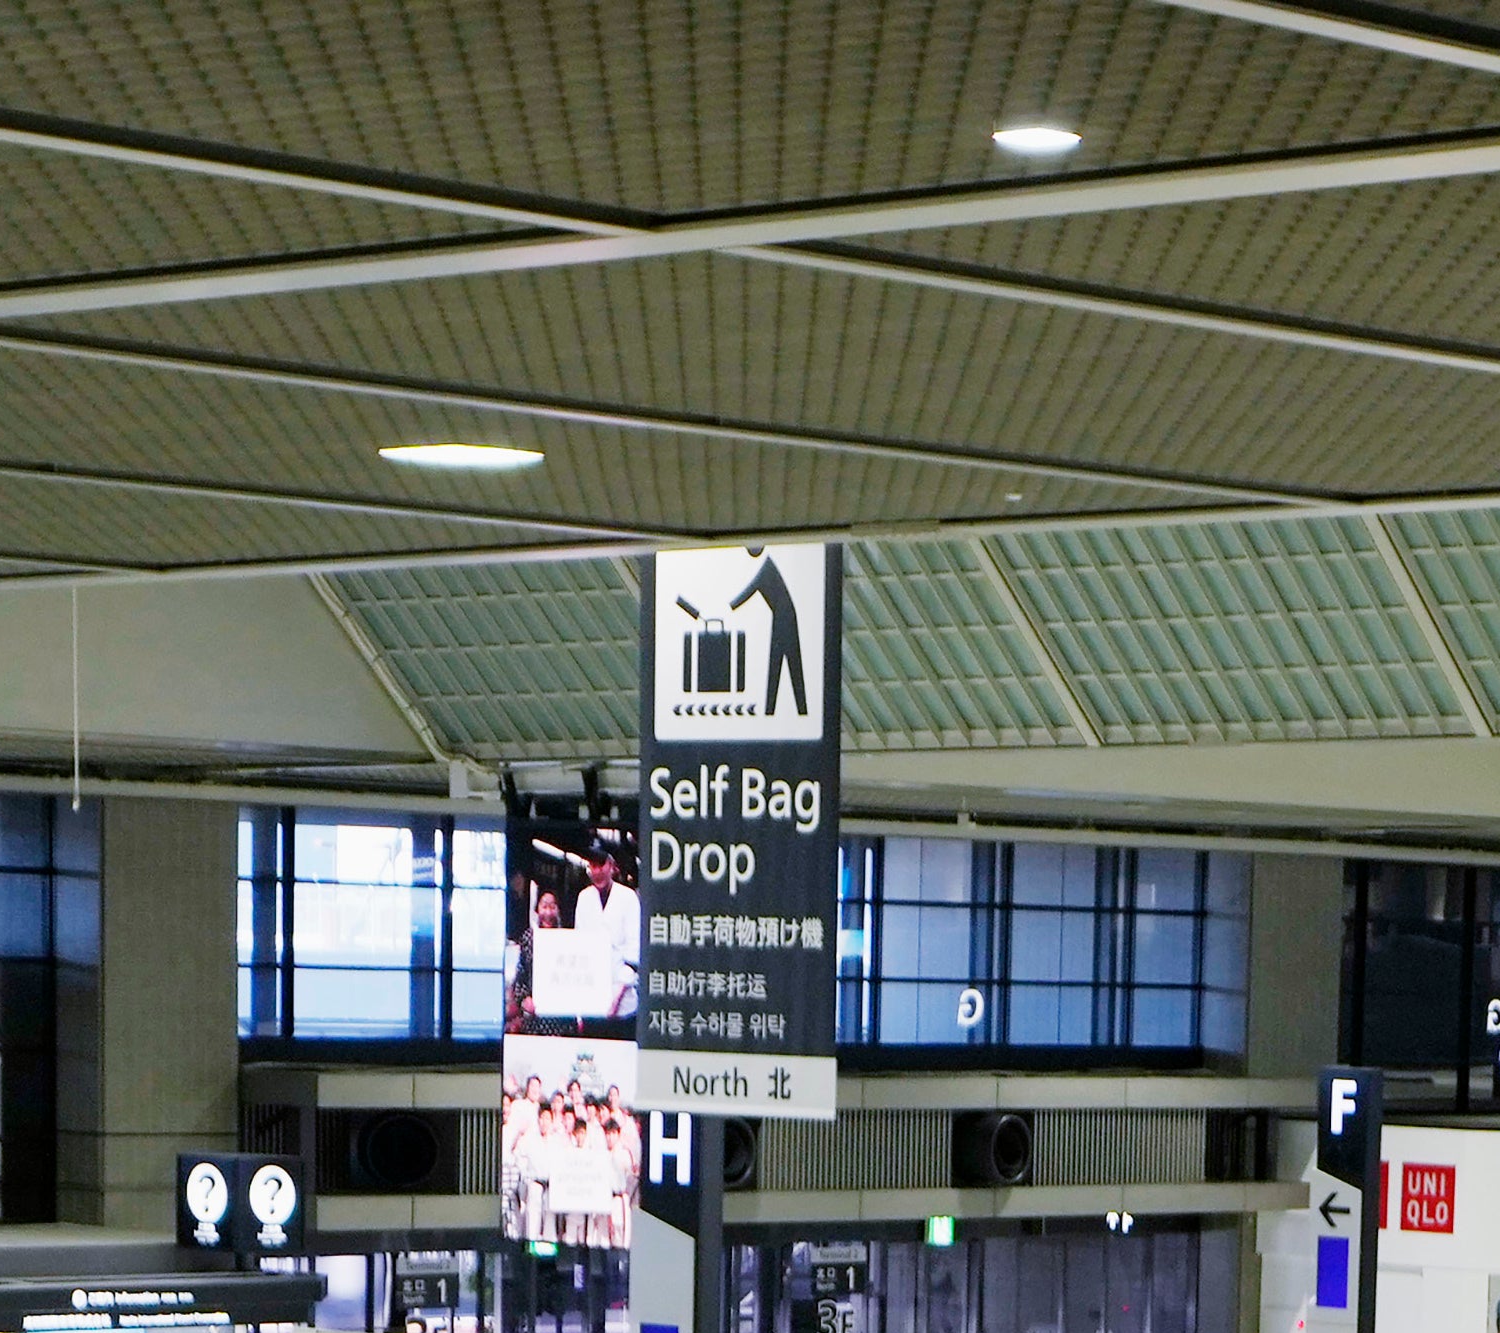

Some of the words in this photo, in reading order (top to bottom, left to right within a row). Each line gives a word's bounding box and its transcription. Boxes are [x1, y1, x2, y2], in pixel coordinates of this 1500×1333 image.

[650, 764, 729, 820] Self
[741, 767, 821, 833] Bag
[651, 830, 755, 897] Drop
[649, 914, 824, 950] 自動手荷物預け機
[648, 969, 767, 999] 自助行李托运
[649, 1009, 685, 1036] 자동
[689, 1010, 744, 1038] 수하물
[750, 1012, 786, 1040] 위탁
[673, 1065, 748, 1098] North
[768, 1065, 791, 1100] 北
[1331, 1078, 1357, 1135] F
[649, 1110, 693, 1186] H
[1407, 1171, 1446, 1197] UNI
[1406, 1201, 1449, 1226] QLO
[437, 1278, 447, 1303] 1
[846, 1265, 855, 1291] 1
